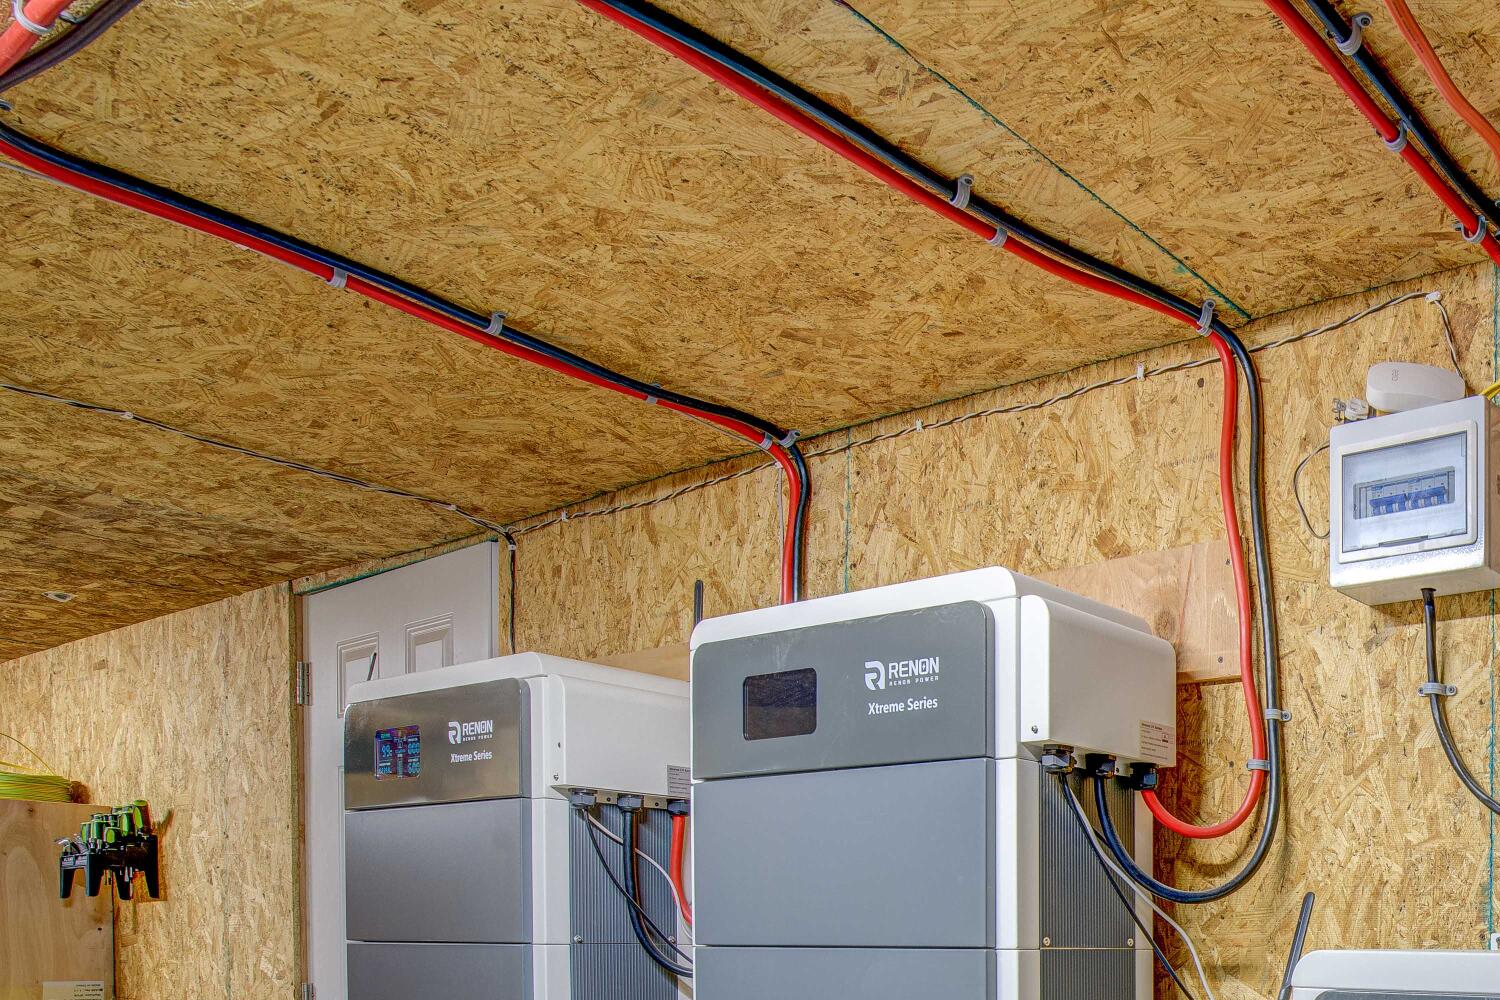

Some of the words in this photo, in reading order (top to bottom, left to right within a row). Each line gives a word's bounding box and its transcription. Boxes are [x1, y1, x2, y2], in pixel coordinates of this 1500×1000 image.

[888, 656, 940, 679] RENON
[868, 702, 905, 715] Xtreme
[907, 696, 938, 710] Series
[462, 719, 493, 736] RENON
[450, 753, 473, 763] Xtreme
[473, 749, 493, 761] Series
